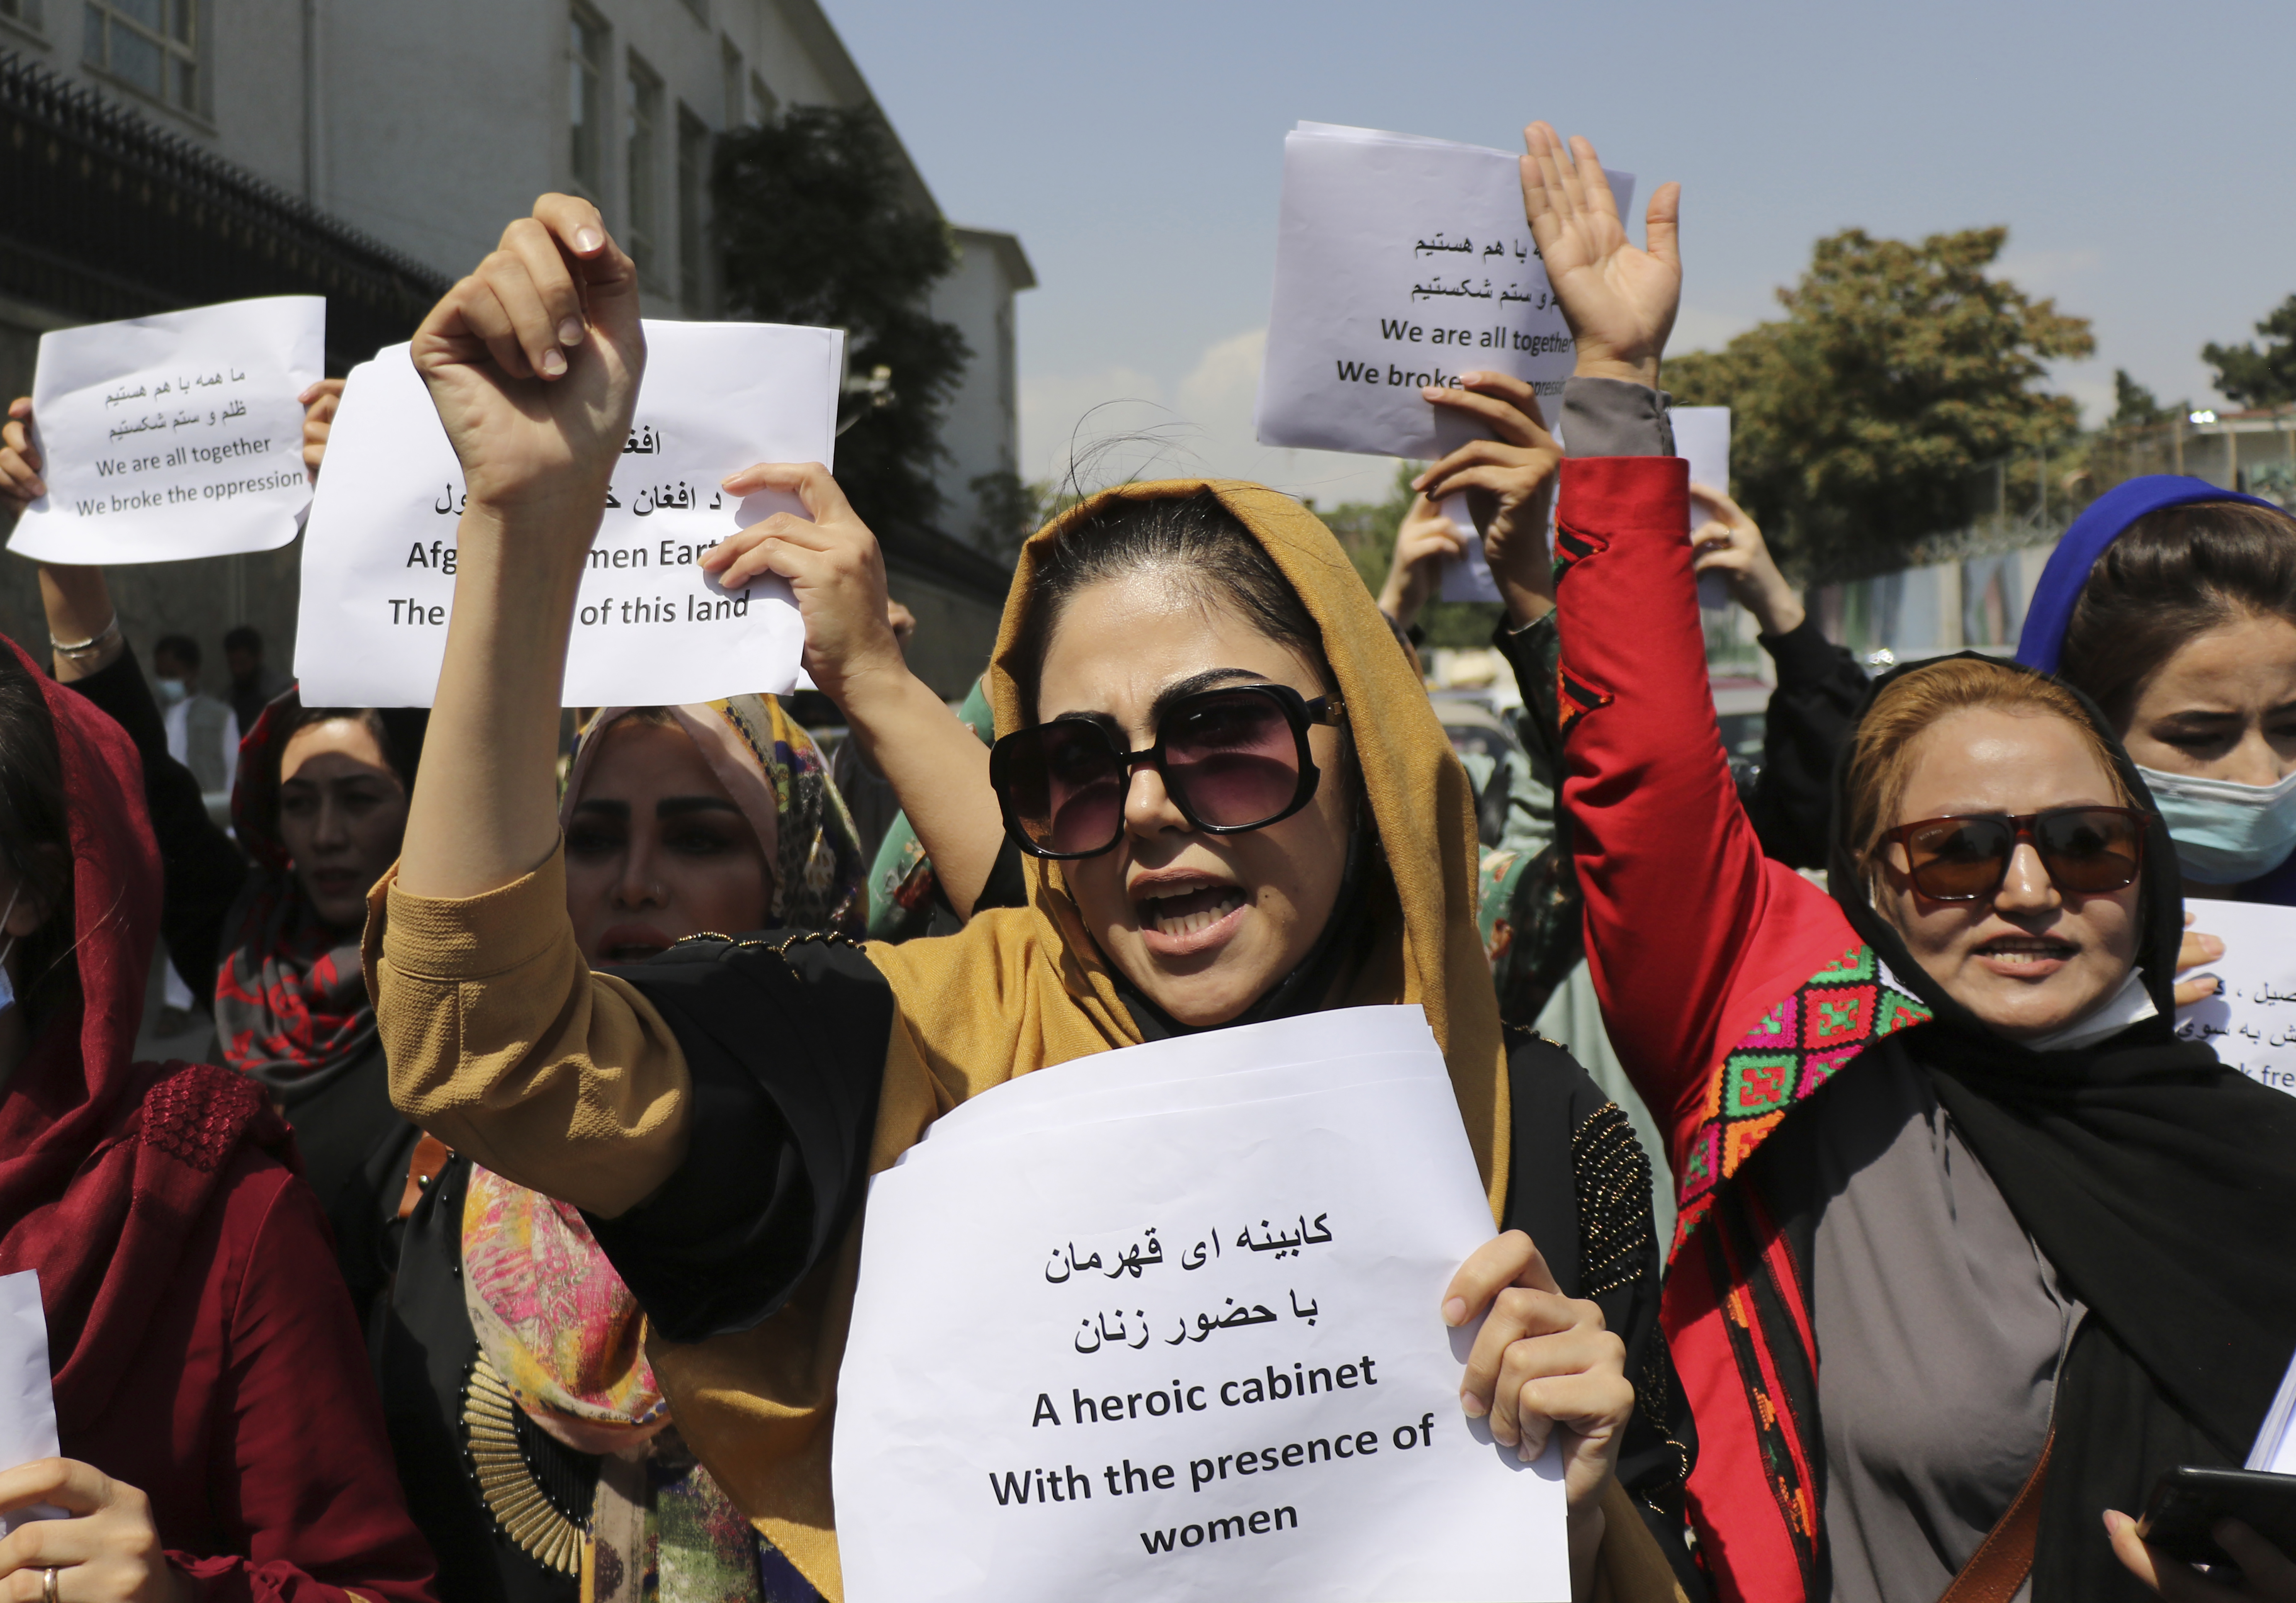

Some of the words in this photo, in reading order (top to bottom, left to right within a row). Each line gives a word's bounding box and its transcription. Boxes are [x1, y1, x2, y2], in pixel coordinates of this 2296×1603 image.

[1415, 232, 1473, 259] هستیم
[1483, 240, 1505, 263] هم
[1514, 238, 1527, 264] با
[1412, 276, 1492, 302] شکستیم
[1500, 283, 1532, 311] ستم
[1536, 293, 1547, 310] و
[1381, 318, 1423, 343] We
[1432, 328, 1473, 346] are
[1480, 326, 1506, 349] all
[1513, 330, 1574, 357] together
[179, 377, 190, 395] با
[196, 373, 223, 387] همه
[230, 368, 246, 382] ما
[1337, 360, 1380, 385] We
[1388, 363, 1463, 390] broke
[105, 385, 147, 409] هستیم
[154, 382, 171, 401] هم
[173, 411, 200, 433] ستم
[207, 411, 216, 426] و
[222, 400, 246, 423] ظلم
[109, 413, 166, 443] شکستیم
[96, 459, 127, 477] We
[132, 456, 161, 472] are
[166, 447, 187, 467] all
[191, 437, 271, 465] together
[77, 499, 106, 517] We
[111, 490, 162, 512] broke
[168, 485, 197, 504] the
[204, 470, 304, 502] oppression
[633, 481, 696, 517] افغان
[709, 492, 722, 510] د
[388, 598, 445, 625] The
[581, 598, 613, 625] of
[621, 597, 676, 624] this
[688, 589, 750, 622] land
[2262, 1065, 2295, 1087] fre
[1181, 1226, 1220, 1271] ای
[1236, 1212, 1332, 1260] کابینه
[1045, 1227, 1163, 1284] قهرمان
[1164, 1297, 1277, 1345] حضور
[1289, 1288, 1318, 1327] با
[1075, 1309, 1149, 1354] زنان
[1032, 1393, 1062, 1427] A
[1072, 1379, 1207, 1424] heroic
[1220, 1355, 1378, 1407] cabinet
[989, 1464, 1091, 1506] With
[1103, 1459, 1175, 1496] the
[1190, 1431, 1378, 1493] presence
[1393, 1412, 1434, 1450] of
[1140, 1506, 1298, 1555] women
